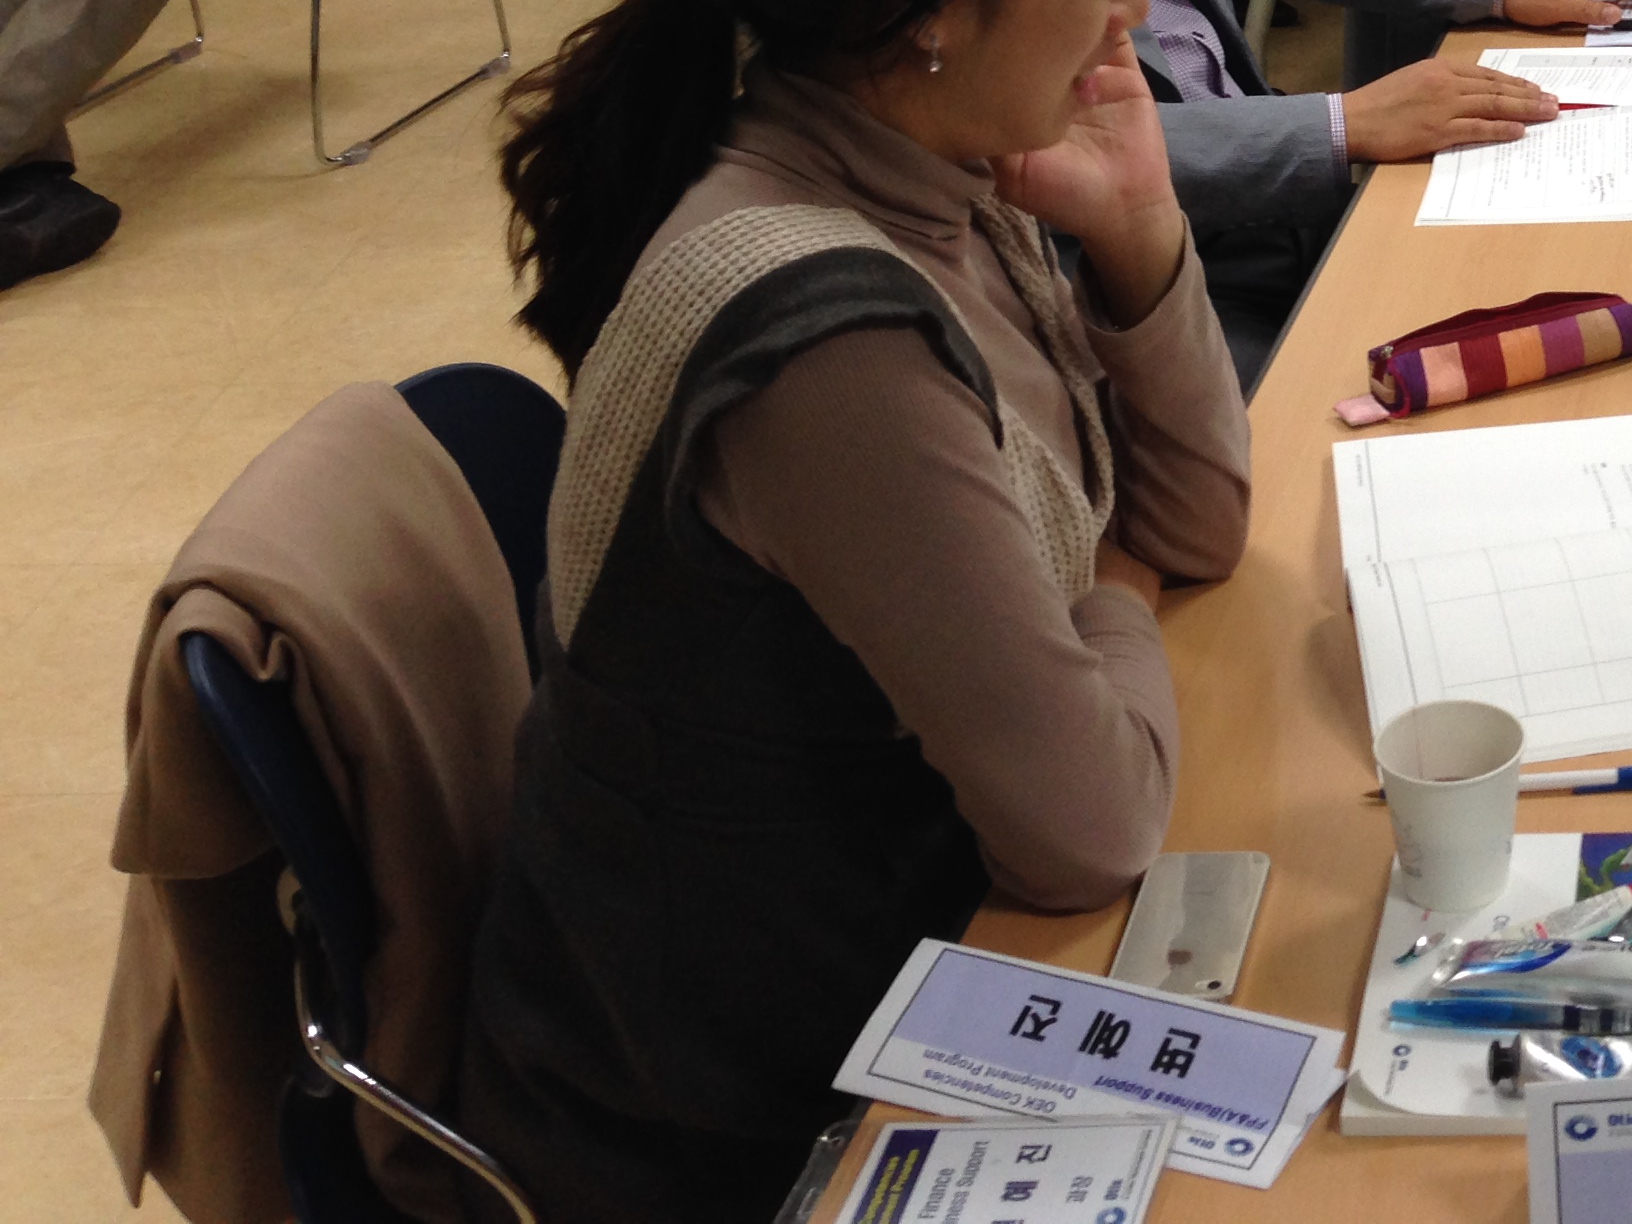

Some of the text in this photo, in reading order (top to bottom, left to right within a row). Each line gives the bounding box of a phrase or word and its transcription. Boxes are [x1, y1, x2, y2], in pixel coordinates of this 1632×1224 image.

[922, 1047, 1078, 1100] Development Program
[923, 1068, 1022, 1106] Competencies
[956, 1140, 990, 1188] Support
[917, 1168, 955, 1219] Finance
